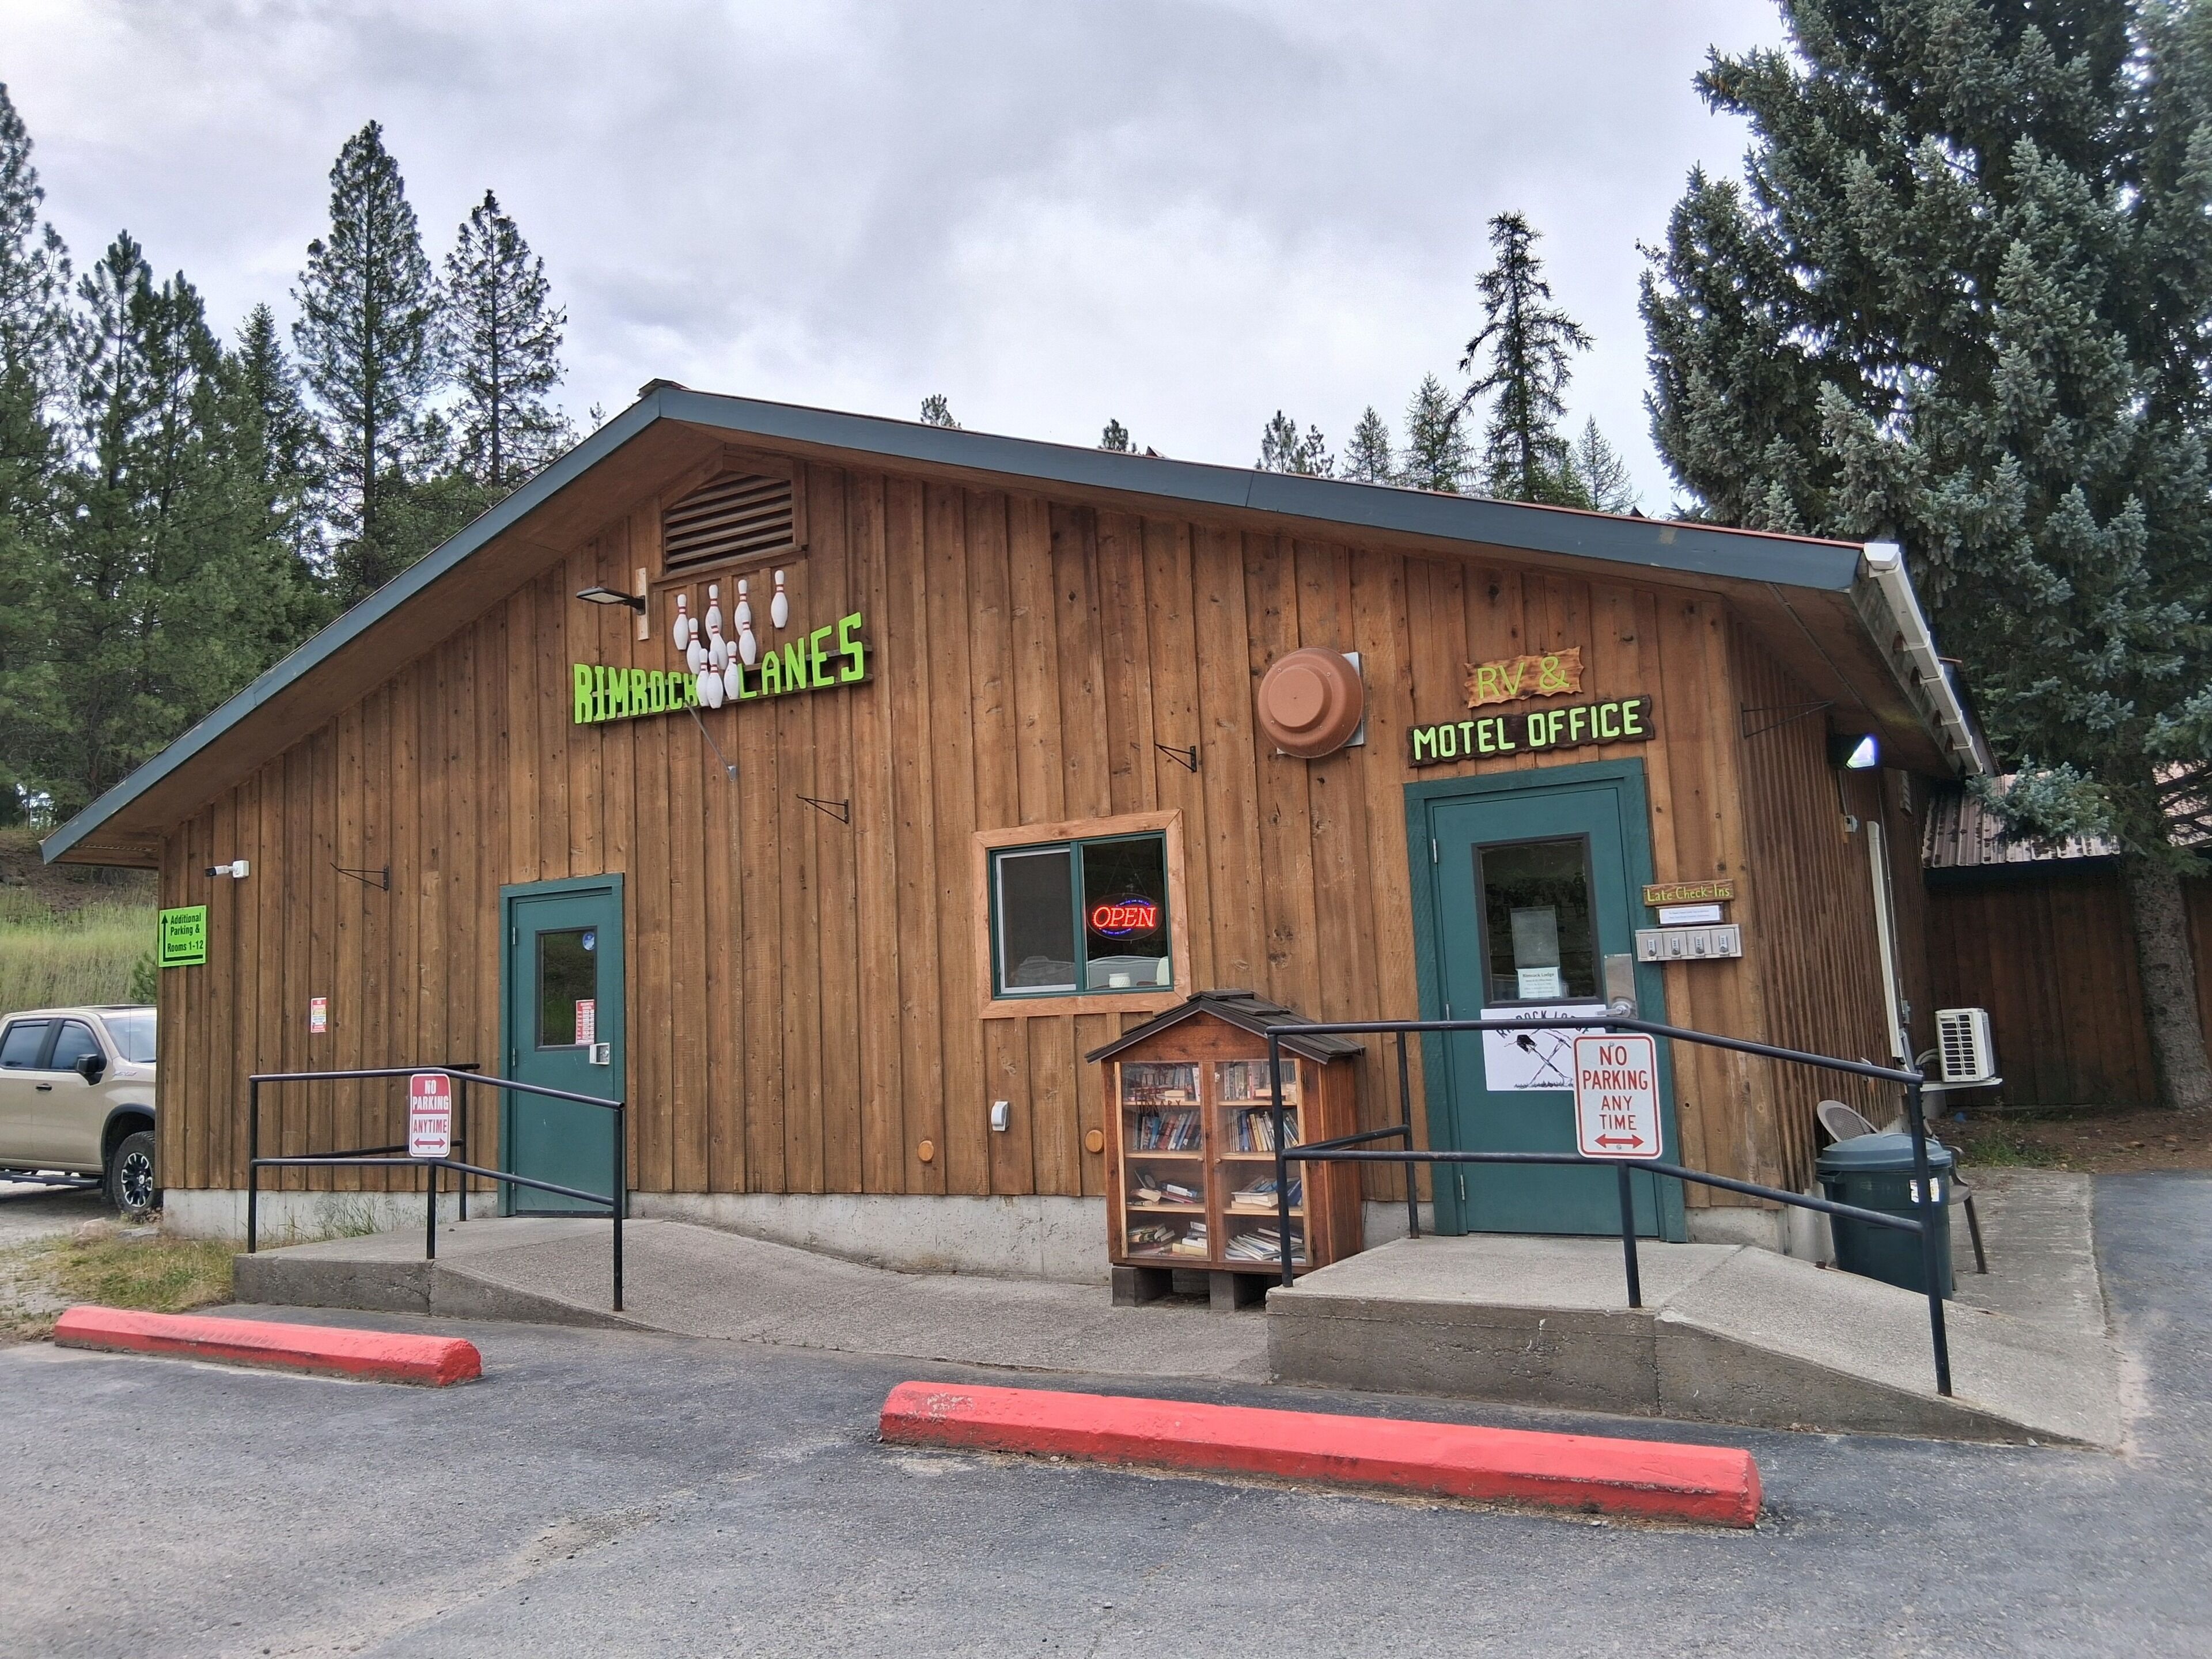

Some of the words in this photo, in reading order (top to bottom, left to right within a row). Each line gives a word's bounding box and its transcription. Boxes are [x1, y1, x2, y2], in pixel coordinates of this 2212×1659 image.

[574, 663, 699, 724] RIMROCK
[737, 612, 863, 699] LANES
[1477, 662, 1525, 699] RV
[1539, 656, 1569, 690] &
[1413, 718, 1516, 760] MOTEL
[1527, 700, 1643, 747] OFFICE
[1646, 888, 1672, 902] Late
[171, 912, 201, 925] Additional
[1092, 906, 1157, 928] OPEN
[171, 925, 193, 936] Parking
[195, 924, 200, 933] &
[168, 943, 187, 953] Rooms
[189, 940, 203, 950] 1-12
[1599, 1046, 1627, 1066] NO
[425, 1080, 437, 1094] NO
[1582, 1070, 1648, 1090] PARKING
[412, 1095, 449, 1111] PARKING
[1601, 1096, 1633, 1111] ANY
[413, 1119, 447, 1134] ANYTIME
[1599, 1115, 1637, 1130] TIME
